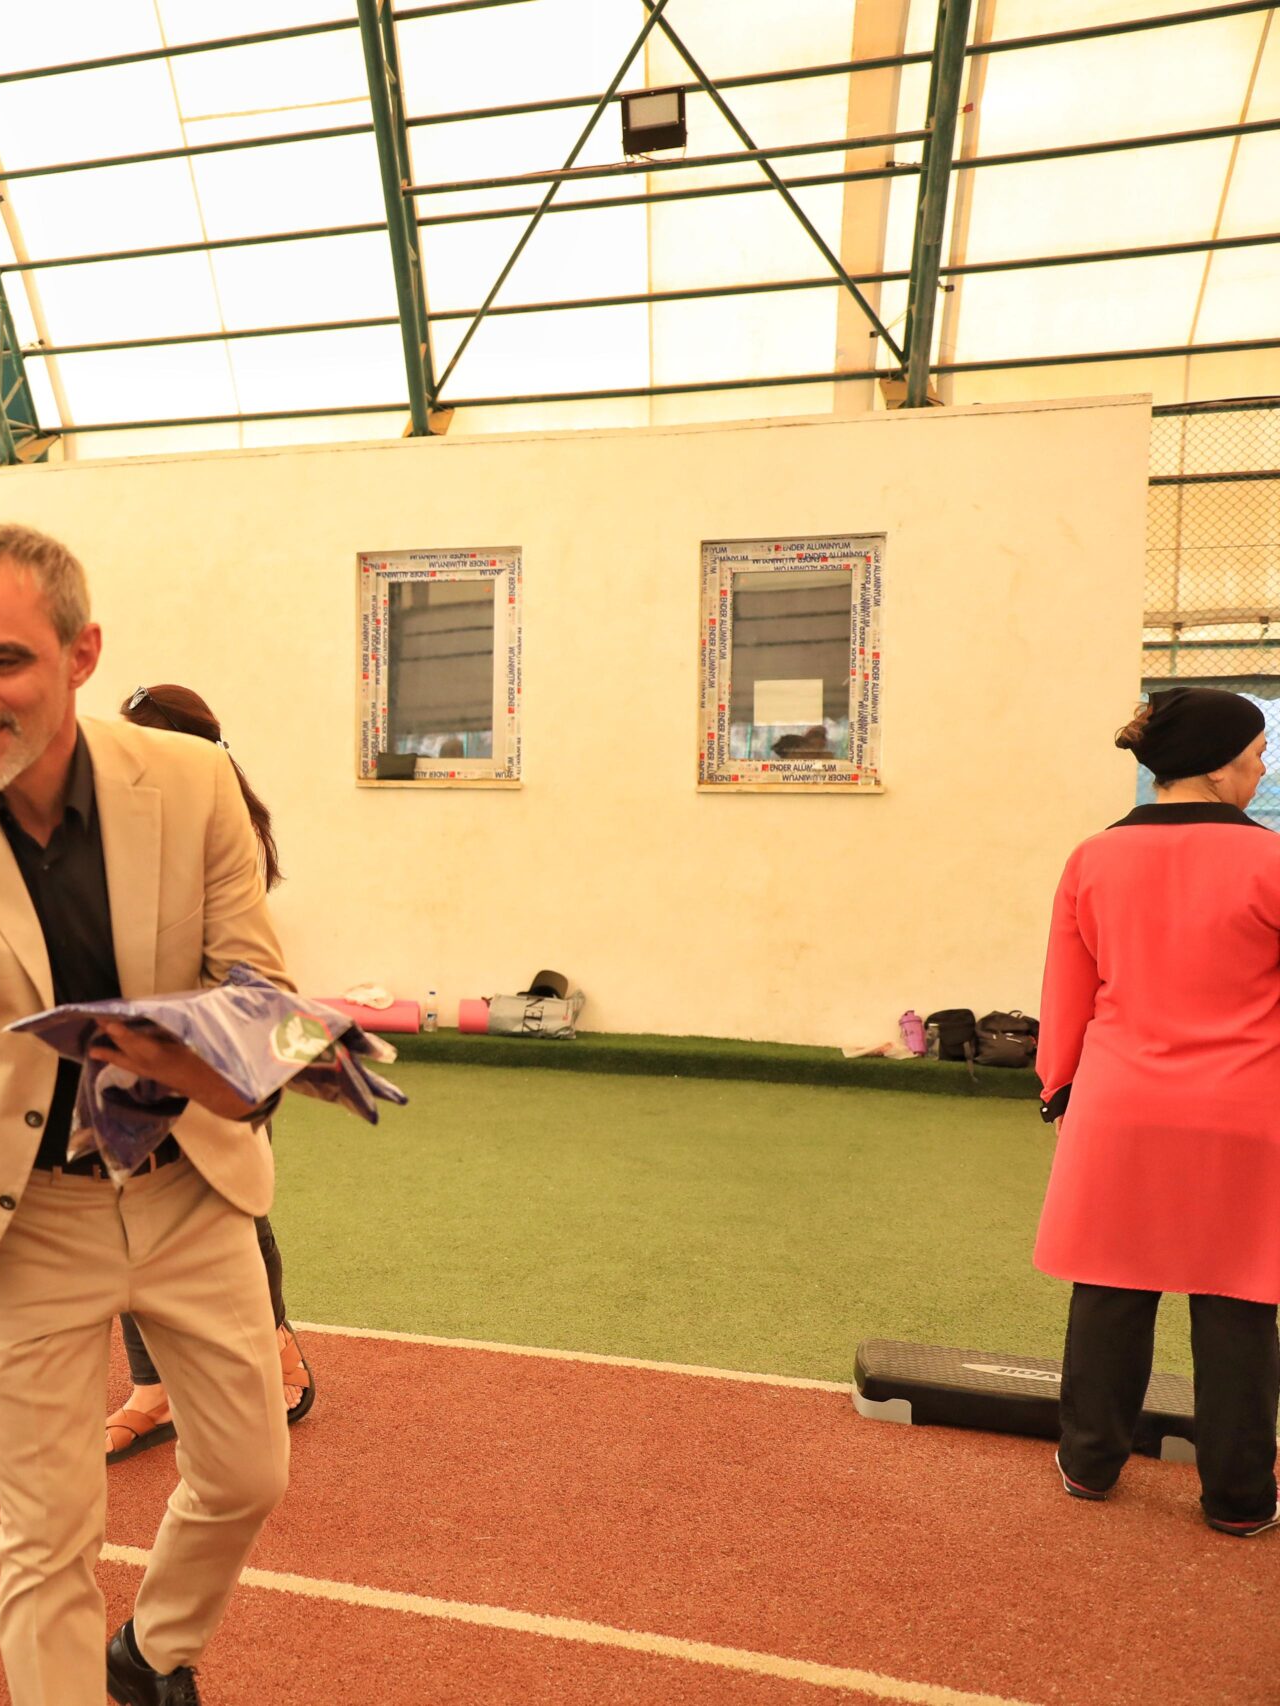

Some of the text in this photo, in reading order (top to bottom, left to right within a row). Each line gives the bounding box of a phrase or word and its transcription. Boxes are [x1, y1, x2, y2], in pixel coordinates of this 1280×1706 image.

[783, 543, 805, 552] ENDER
[720, 596, 728, 618] ENDER
[872, 659, 880, 681] ENDER
[769, 764, 791, 772] ENDER
[828, 773, 852, 781] ENDER
